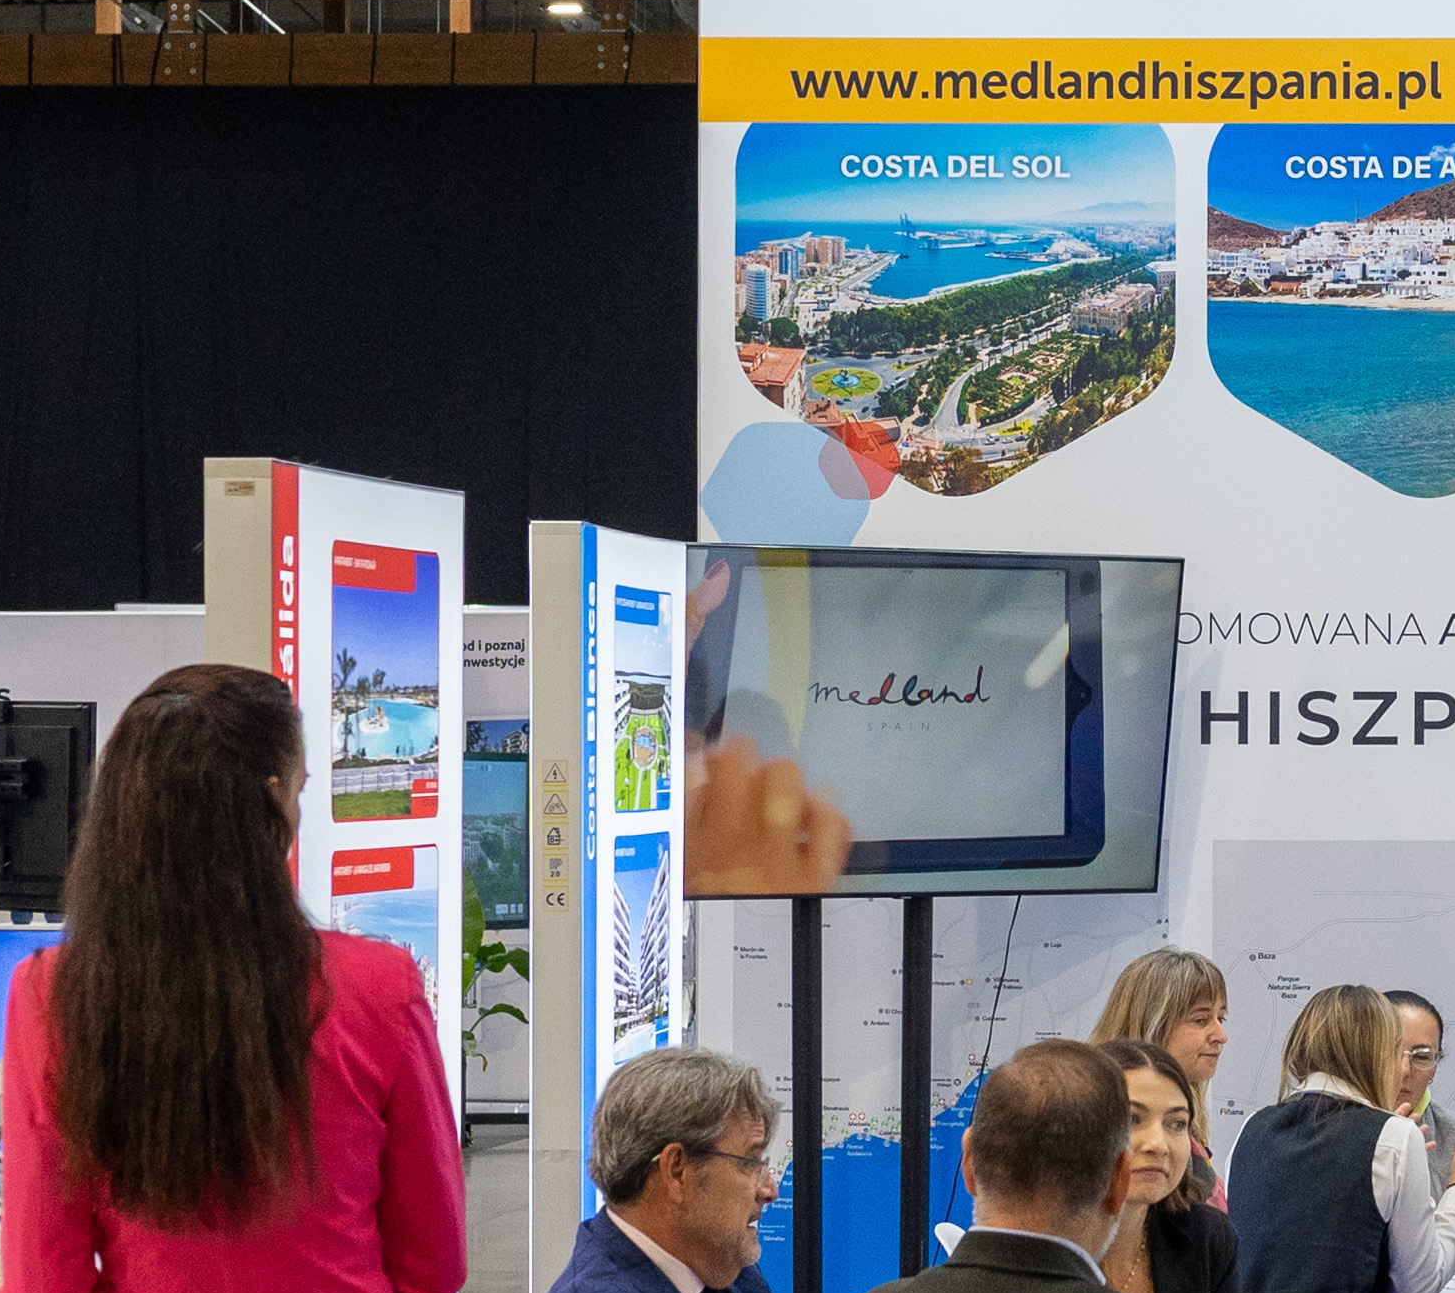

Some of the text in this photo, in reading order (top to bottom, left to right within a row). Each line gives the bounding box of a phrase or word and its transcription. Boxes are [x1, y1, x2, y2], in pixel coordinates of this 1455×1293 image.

[790, 60, 1443, 109] www.medlandhiszpania.pl
[840, 154, 1071, 180] COSTA DEL SOL
[1285, 154, 1386, 180] COSTA
[1392, 154, 1431, 179] DE
[1176, 612, 1427, 646] OMOWANA
[484, 639, 526, 655] poznaj
[463, 655, 526, 670] nwestycje
[586, 581, 596, 742] Blanca
[808, 665, 991, 707] medland
[866, 721, 932, 732] SPAIN
[1258, 952, 1276, 960] Baza
[1277, 975, 1300, 983] Parque
